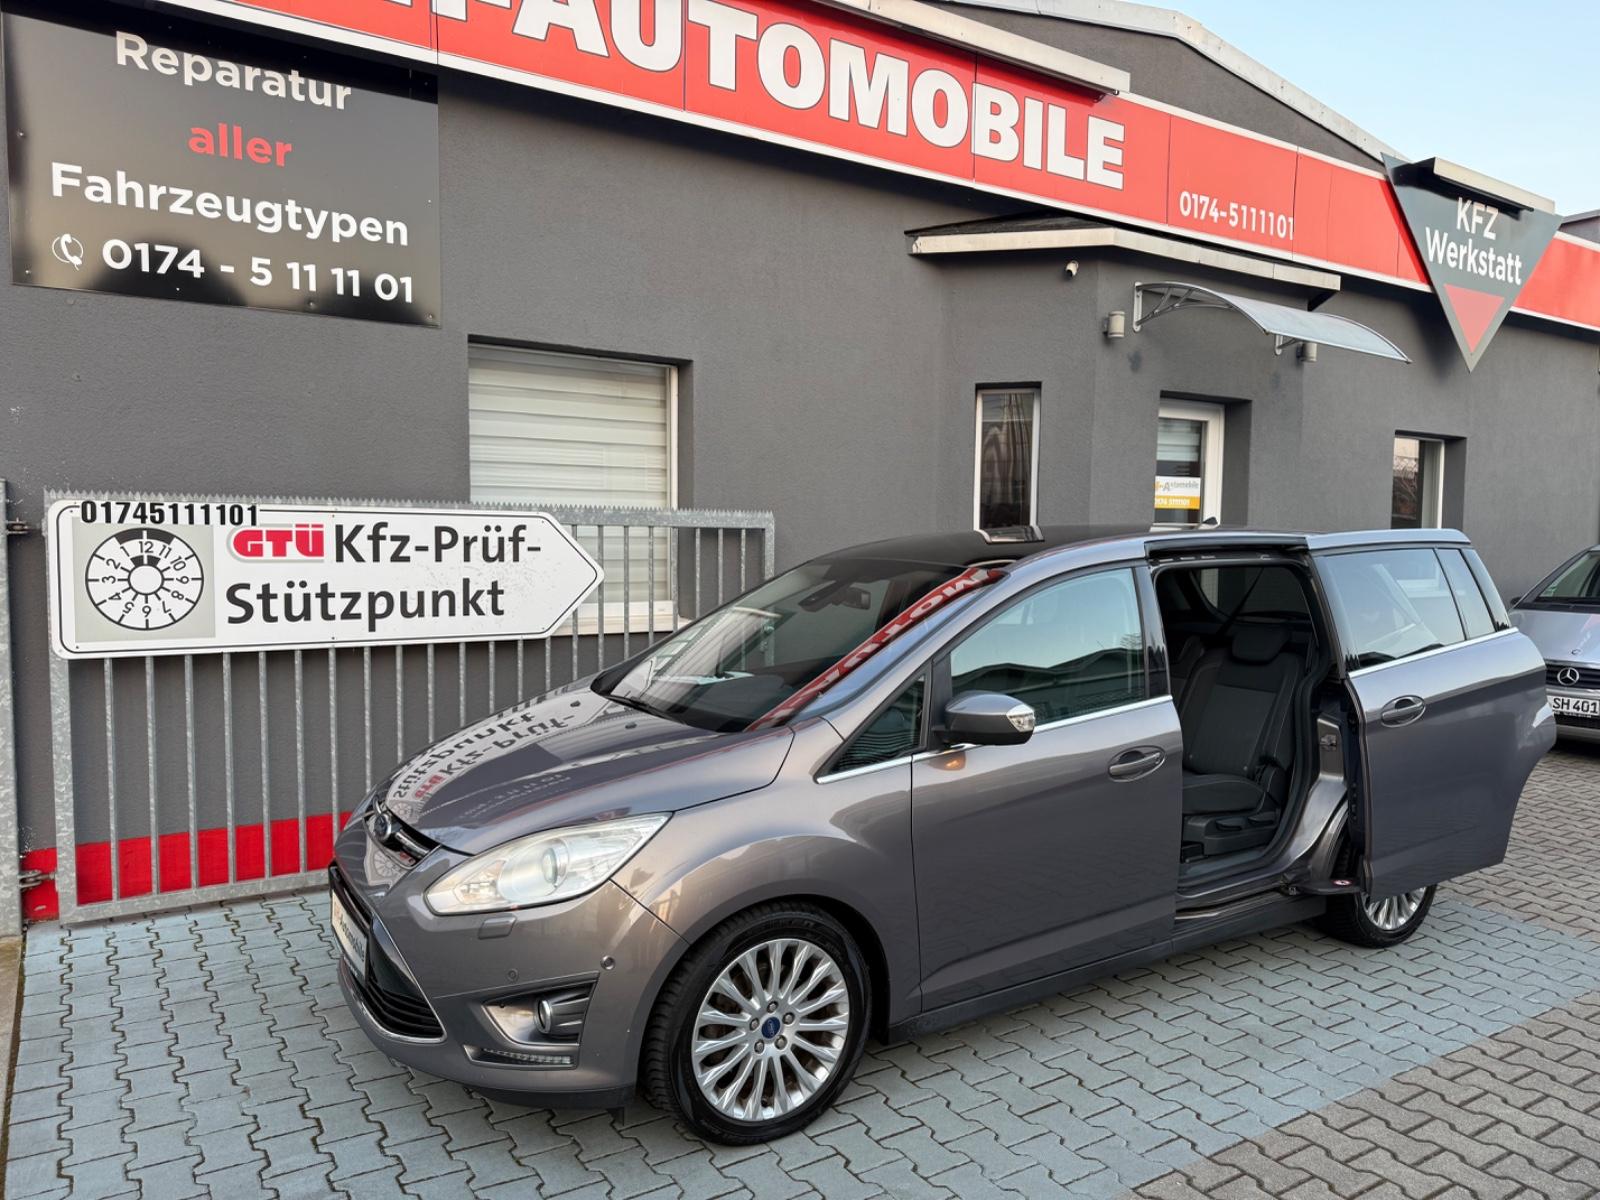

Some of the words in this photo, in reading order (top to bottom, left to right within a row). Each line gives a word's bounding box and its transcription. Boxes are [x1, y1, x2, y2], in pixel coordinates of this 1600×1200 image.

[115, 31, 352, 110] Reparatur
[187, 123, 292, 167] aller
[51, 162, 409, 247] Fahrzeugtypen
[1179, 190, 1294, 241] 0174-5111101
[1456, 197, 1499, 240] KFZ
[102, 239, 205, 280] 0174
[250, 257, 273, 287] 5
[287, 261, 318, 293] 11
[331, 267, 361, 298] 11
[374, 272, 414, 304] 01
[1425, 226, 1522, 285] Werkstatt
[81, 500, 258, 527] 01745111101
[138, 540, 155, 554] 12
[233, 523, 325, 558] GTÜ
[335, 521, 541, 562] Kfz-Prüf-
[101, 575, 117, 584] 3
[105, 558, 121, 570] 2
[170, 556, 187, 572] 10
[226, 577, 505, 633] Stützpunkt
[1552, 697, 1570, 710] SH
[1572, 700, 1598, 714] 401
